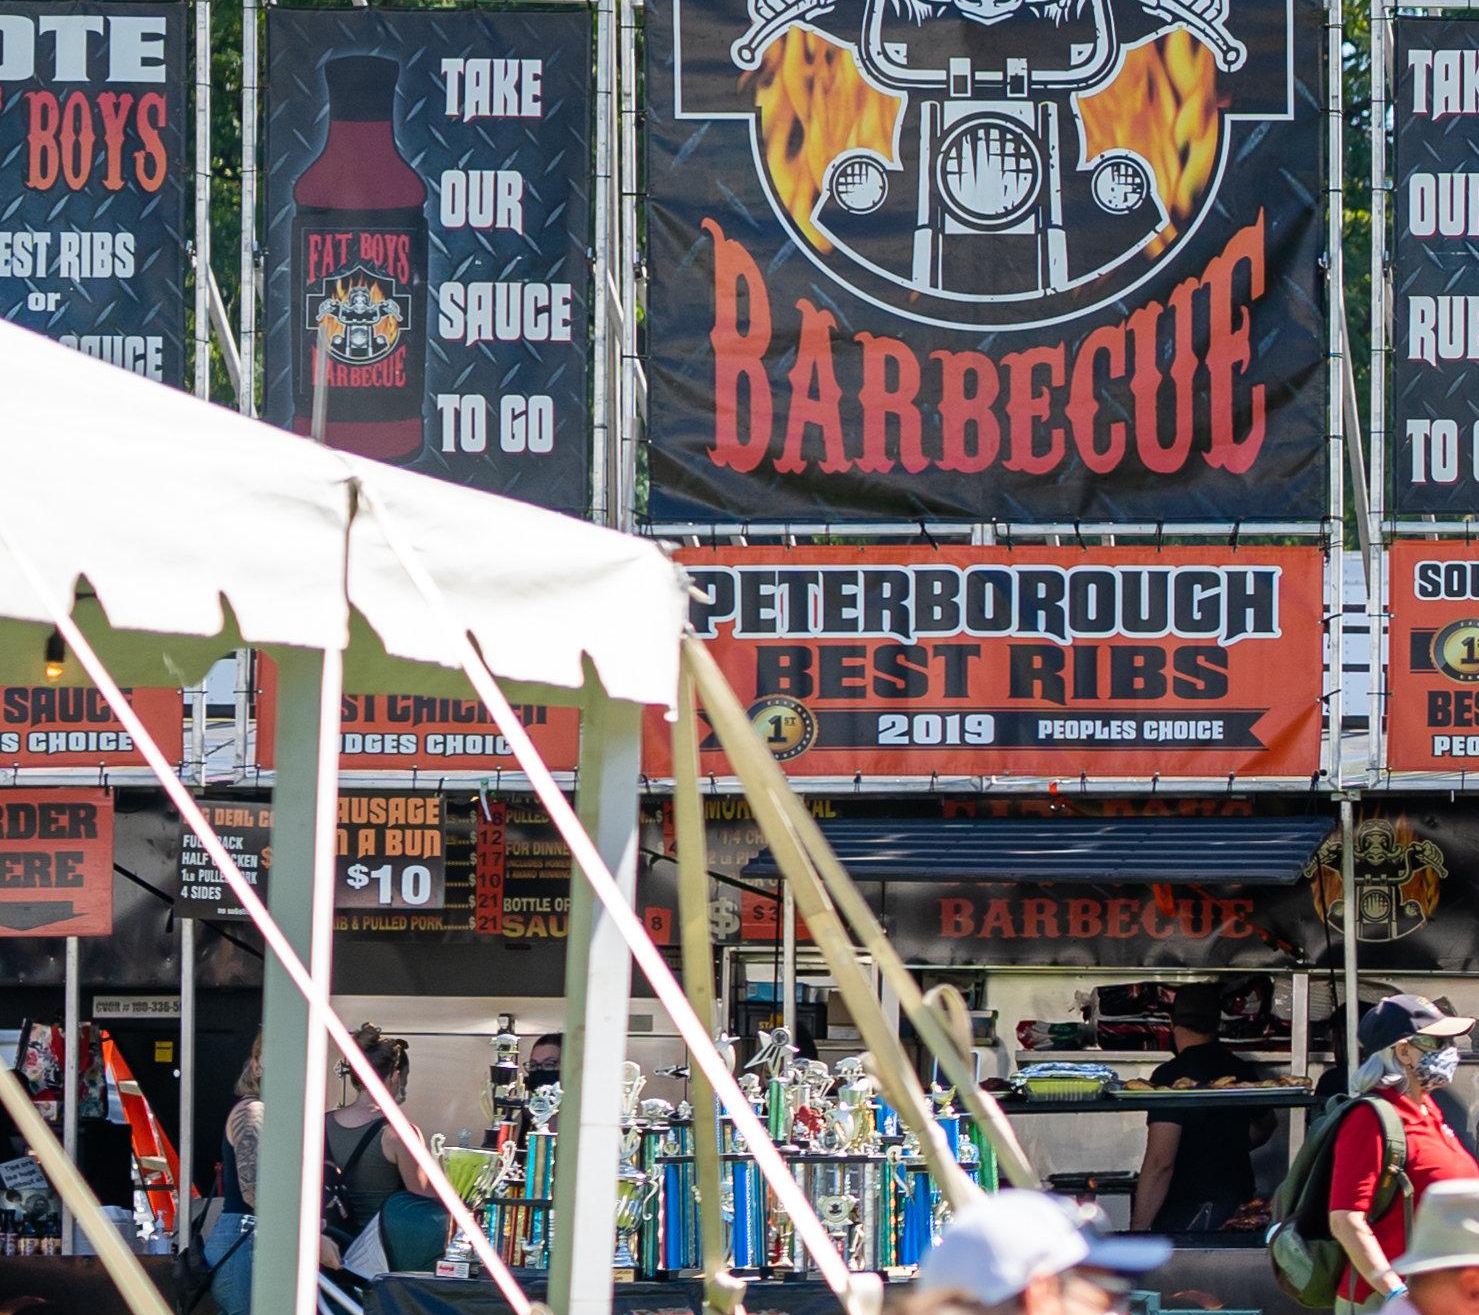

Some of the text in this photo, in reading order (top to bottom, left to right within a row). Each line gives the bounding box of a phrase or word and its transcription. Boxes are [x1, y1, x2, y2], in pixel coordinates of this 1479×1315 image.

[441, 58, 542, 120] TAKE
[439, 170, 523, 235] OUR
[438, 282, 573, 343] SAUCE
[701, 206, 1270, 475] BARBECUE
[438, 394, 555, 453] TO GO
[939, 897, 1256, 939] BARBECUE
